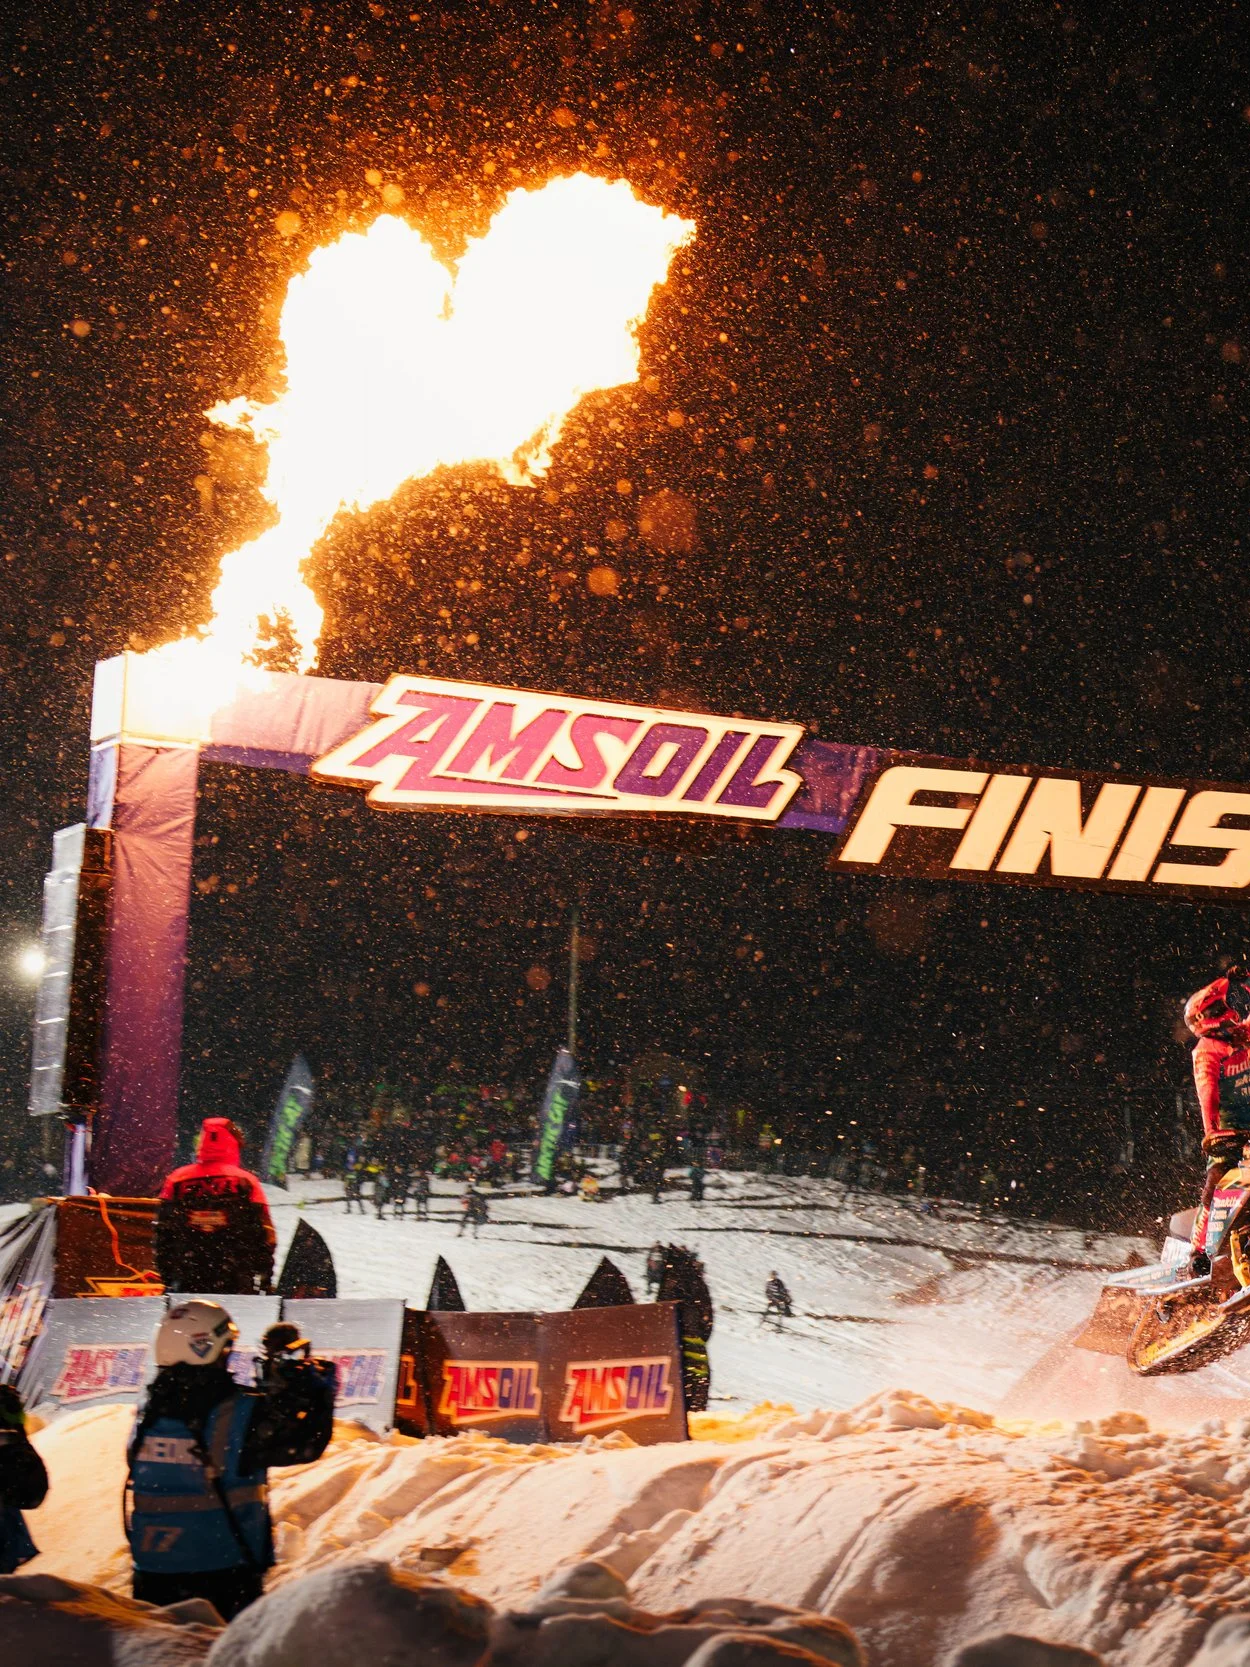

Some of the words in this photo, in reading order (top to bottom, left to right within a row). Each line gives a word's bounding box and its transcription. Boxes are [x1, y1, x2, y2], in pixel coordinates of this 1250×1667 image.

[342, 688, 790, 810] AMSOIL
[446, 1365, 538, 1418] AMSOIL
[565, 1363, 670, 1425] AMSOIL
[141, 1525, 183, 1553] 17
